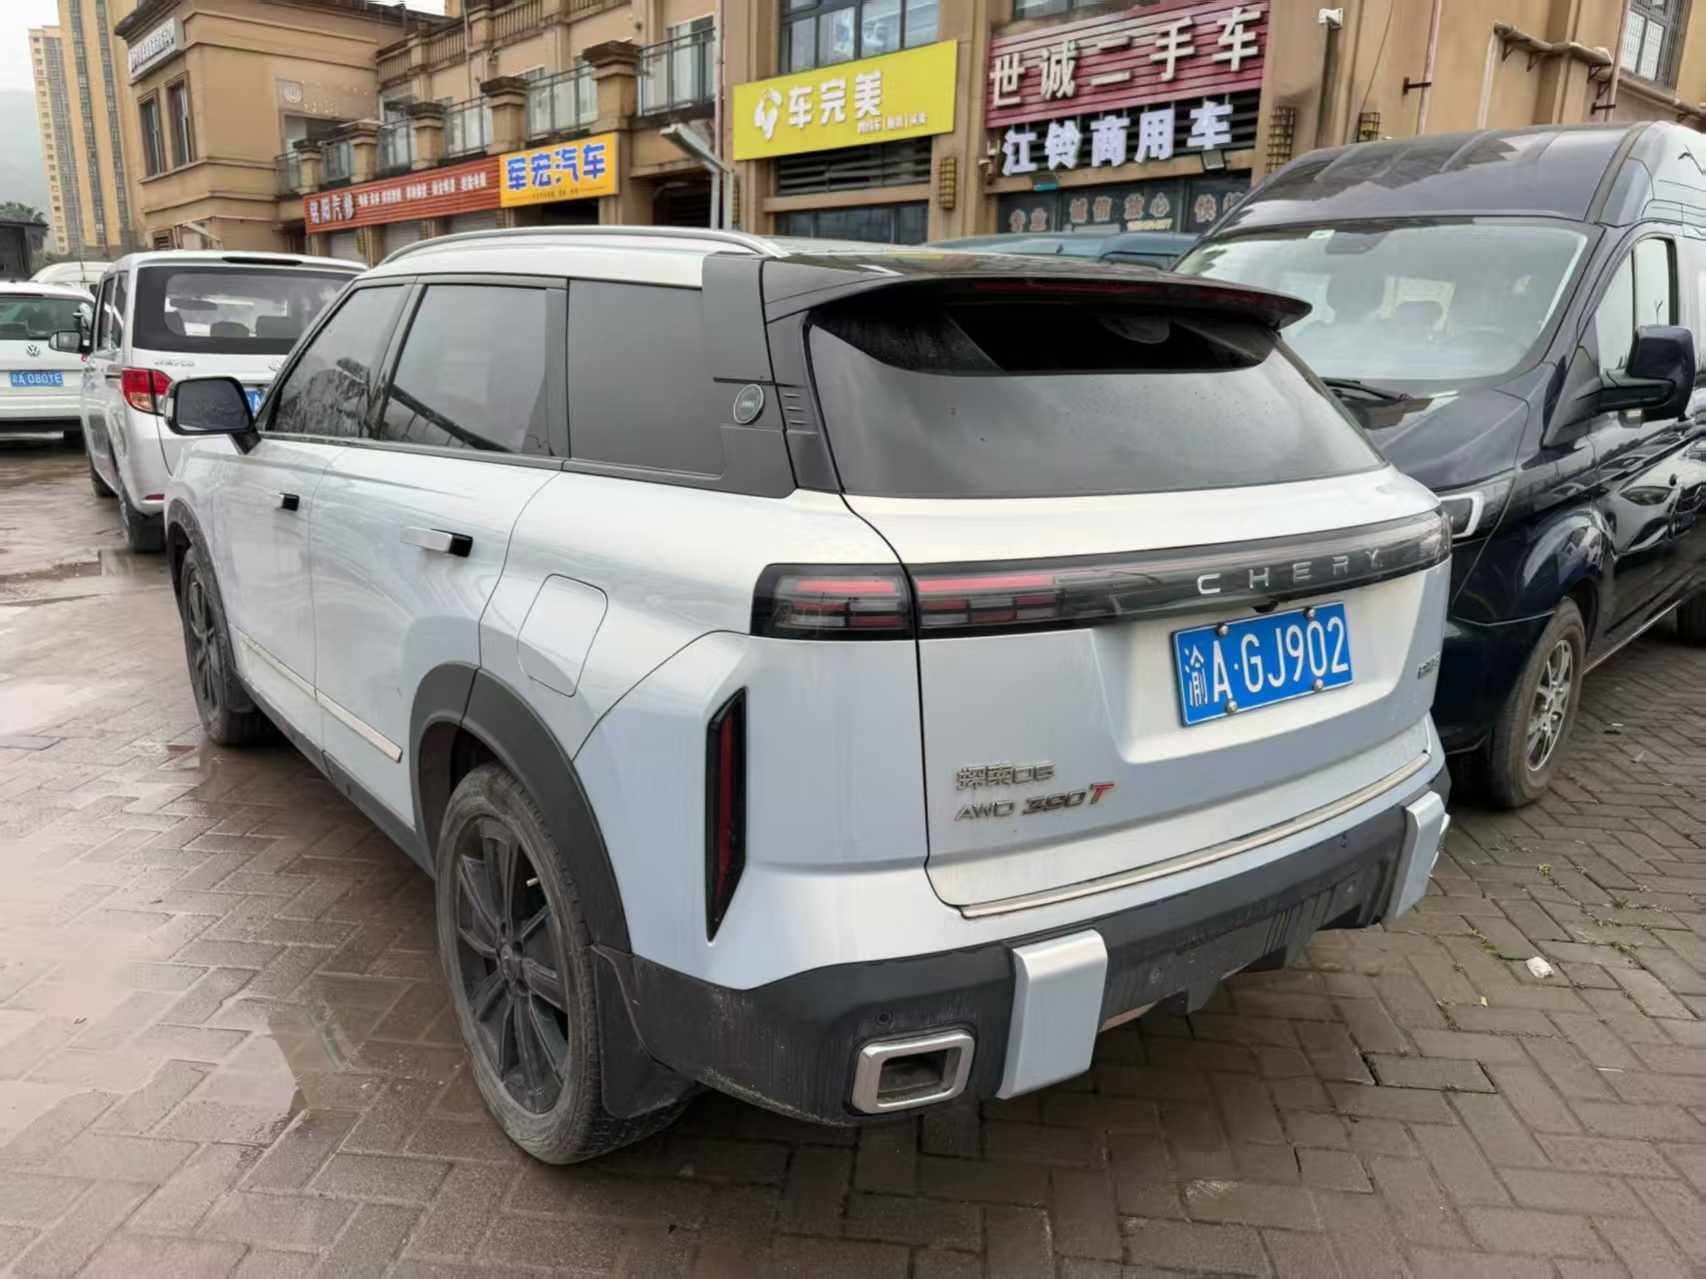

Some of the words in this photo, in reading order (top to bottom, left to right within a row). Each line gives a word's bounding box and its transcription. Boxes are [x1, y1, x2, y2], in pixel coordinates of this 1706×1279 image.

[990, 7, 1262, 108] 世诚二手车
[788, 70, 882, 128] 车完美
[1002, 101, 1234, 176] 江铃商用车
[1197, 549, 1380, 595] CHERY
[954, 799, 1015, 822] AWD
